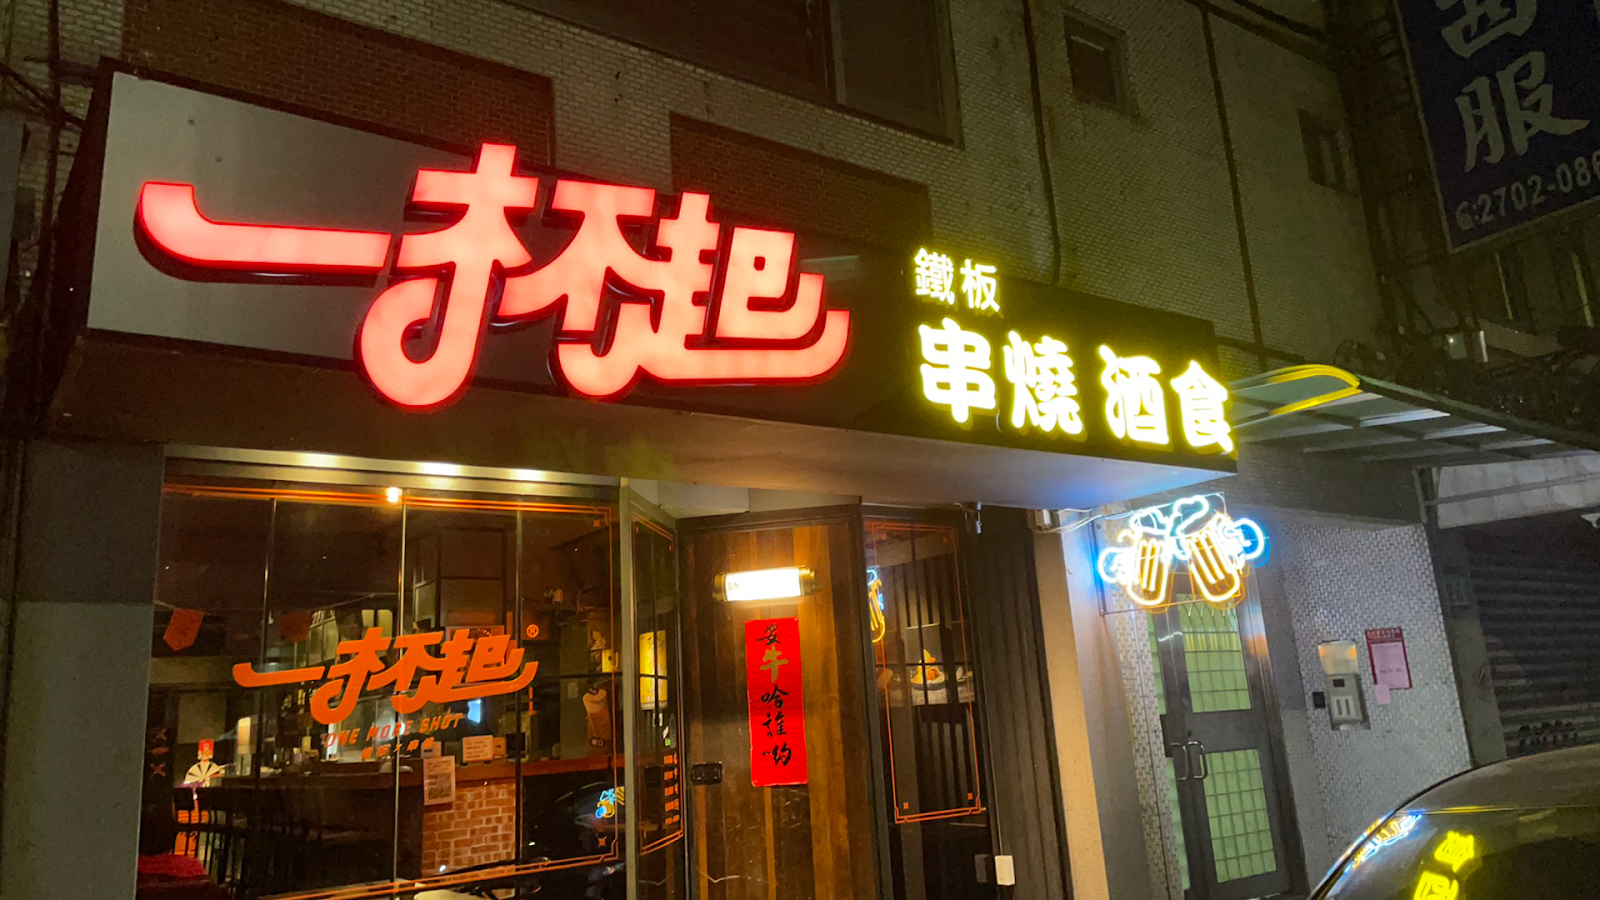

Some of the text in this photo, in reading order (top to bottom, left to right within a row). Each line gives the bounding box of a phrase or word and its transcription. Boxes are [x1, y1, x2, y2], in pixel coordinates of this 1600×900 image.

[914, 248, 1000, 313] 鐵板
[324, 712, 464, 748] ONE MORE SHOT
